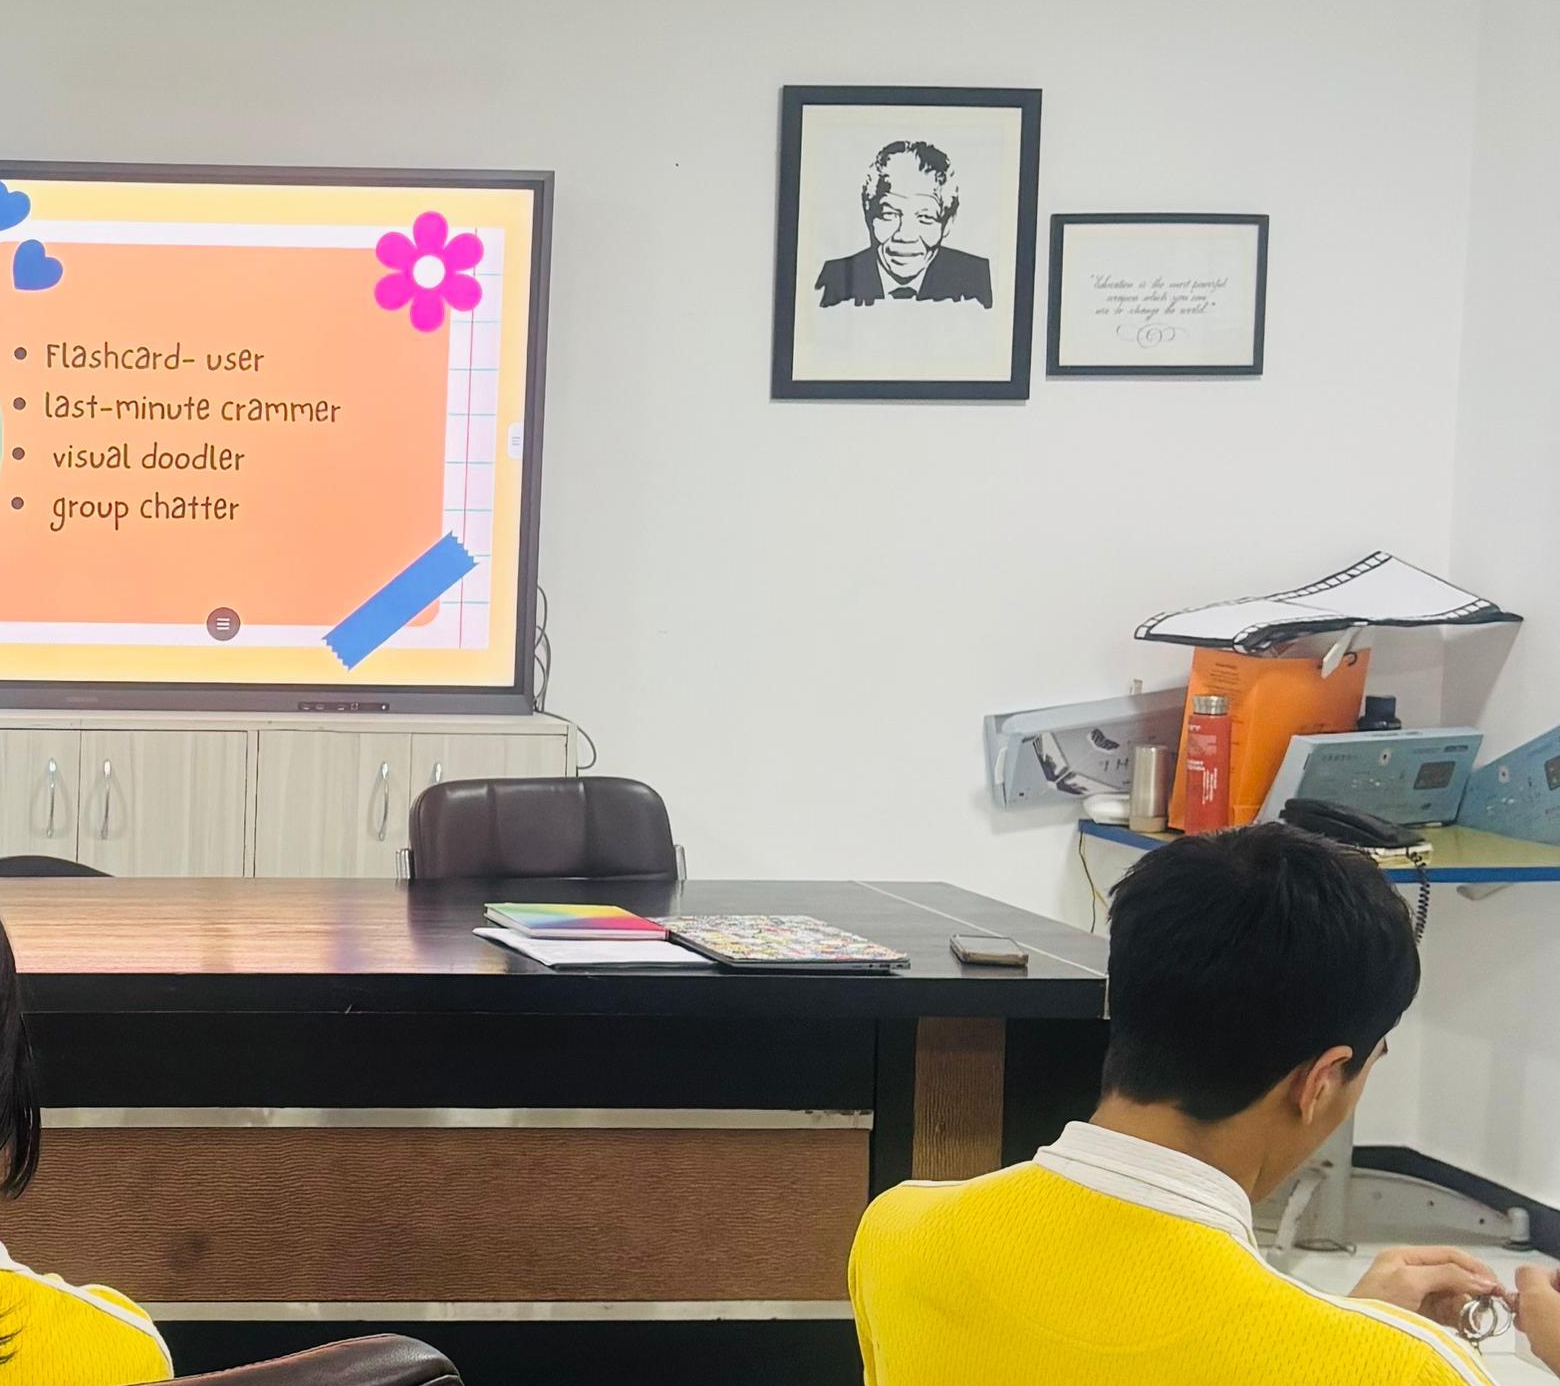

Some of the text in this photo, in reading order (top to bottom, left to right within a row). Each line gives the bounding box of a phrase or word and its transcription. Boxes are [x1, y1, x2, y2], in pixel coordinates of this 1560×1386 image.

[206, 349, 264, 372] user
[44, 391, 342, 423] last-minute crammer
[53, 441, 245, 471] visual doodler
[50, 491, 240, 532] group chatter
